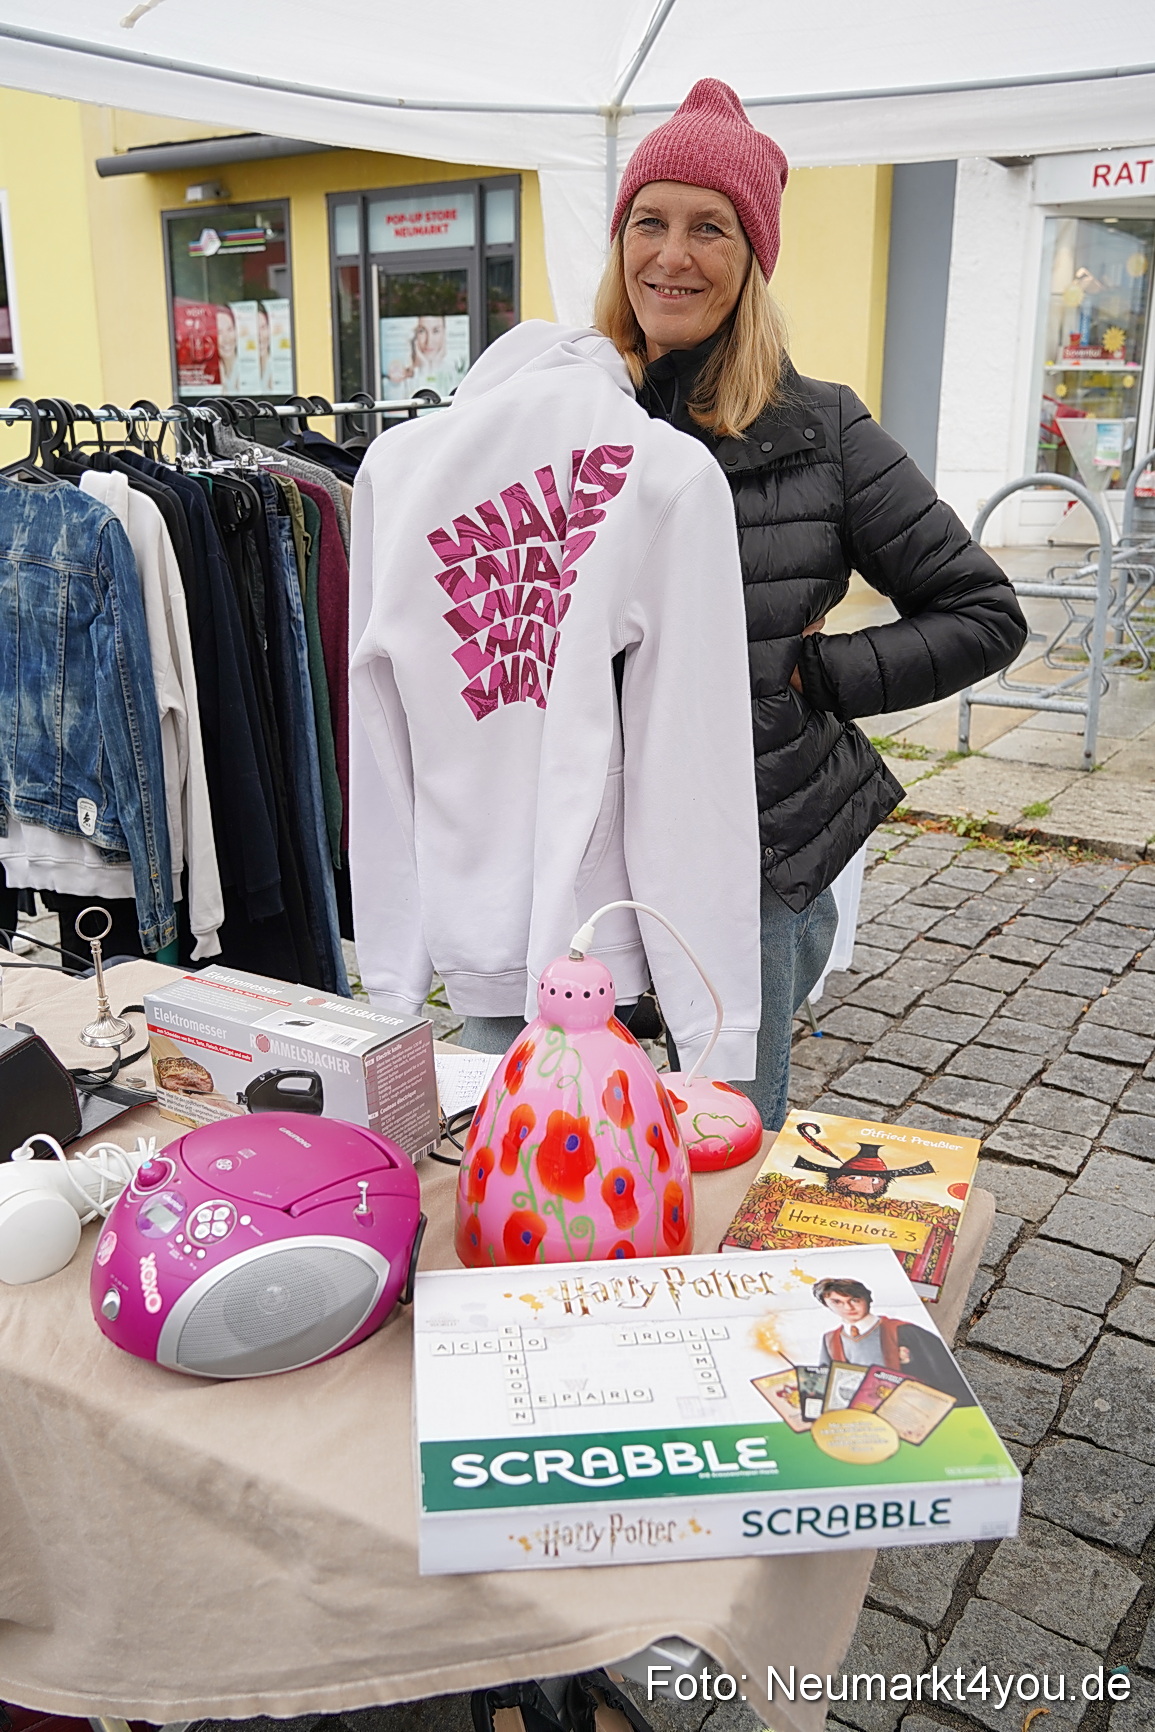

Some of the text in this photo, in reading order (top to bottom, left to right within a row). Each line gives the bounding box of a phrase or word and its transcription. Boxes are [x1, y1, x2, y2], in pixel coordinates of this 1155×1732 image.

[394, 223, 449, 237] NEUMARKT
[425, 208, 457, 222] STORE
[205, 971, 283, 995] Elektromesser
[153, 1006, 227, 1040] Elektromesser
[860, 1127, 963, 1151] Otfried Preußler
[788, 1209, 917, 1243] Hotzenplotz 3
[139, 1251, 162, 1314] XOXO
[554, 1266, 778, 1316] Harry Potter
[451, 1437, 777, 1487] SCRABBLE
[539, 1513, 677, 1557] Harry Potter
[742, 1498, 952, 1538] SCRABBLE
